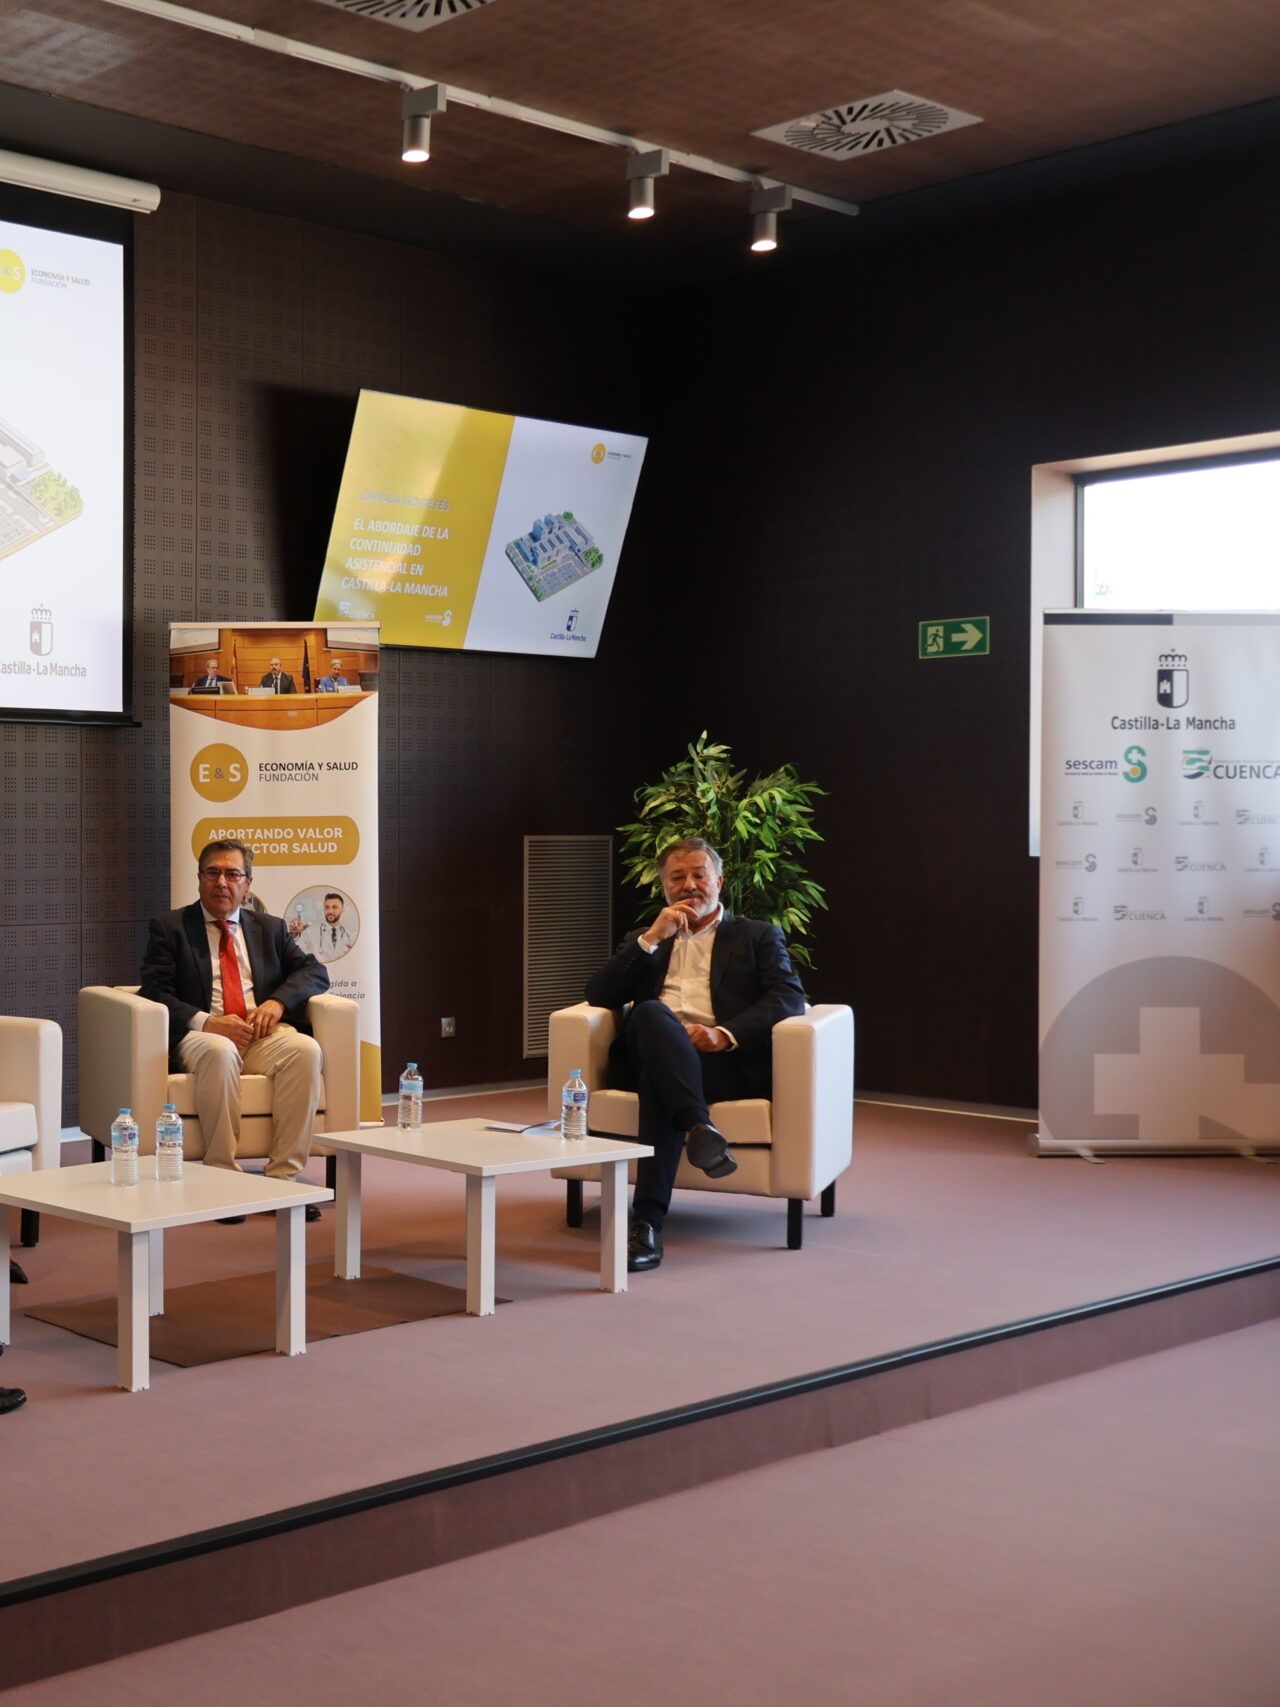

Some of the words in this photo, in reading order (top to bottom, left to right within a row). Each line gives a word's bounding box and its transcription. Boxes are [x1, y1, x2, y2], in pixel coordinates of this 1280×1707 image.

[354, 518, 365, 531] EL
[367, 520, 420, 537] ABORDAJE
[422, 526, 435, 538] DE
[437, 528, 449, 540] LA
[350, 537, 421, 556] CONTINUIDAD
[345, 557, 408, 575] ASISTENCIAL
[410, 563, 424, 576] EN
[342, 577, 402, 593] CASTILLA-LA
[404, 582, 448, 597] MANCHA
[50, 662, 87, 677] Mancha
[1110, 716, 1181, 731] Castilla-La
[1186, 716, 1236, 731] Mancha
[259, 760, 315, 772] ECONOMÍA
[318, 763, 323, 771] Y
[326, 762, 359, 771] SALUD
[1065, 759, 1118, 770] sescam
[259, 771, 319, 782] FUNDACIÓN
[209, 828, 294, 840] APORTANDO
[297, 828, 342, 838] VALOR
[292, 842, 337, 853] SALUD
[1190, 863, 1227, 872] CUENCA
[1128, 912, 1166, 921] CUENCA
